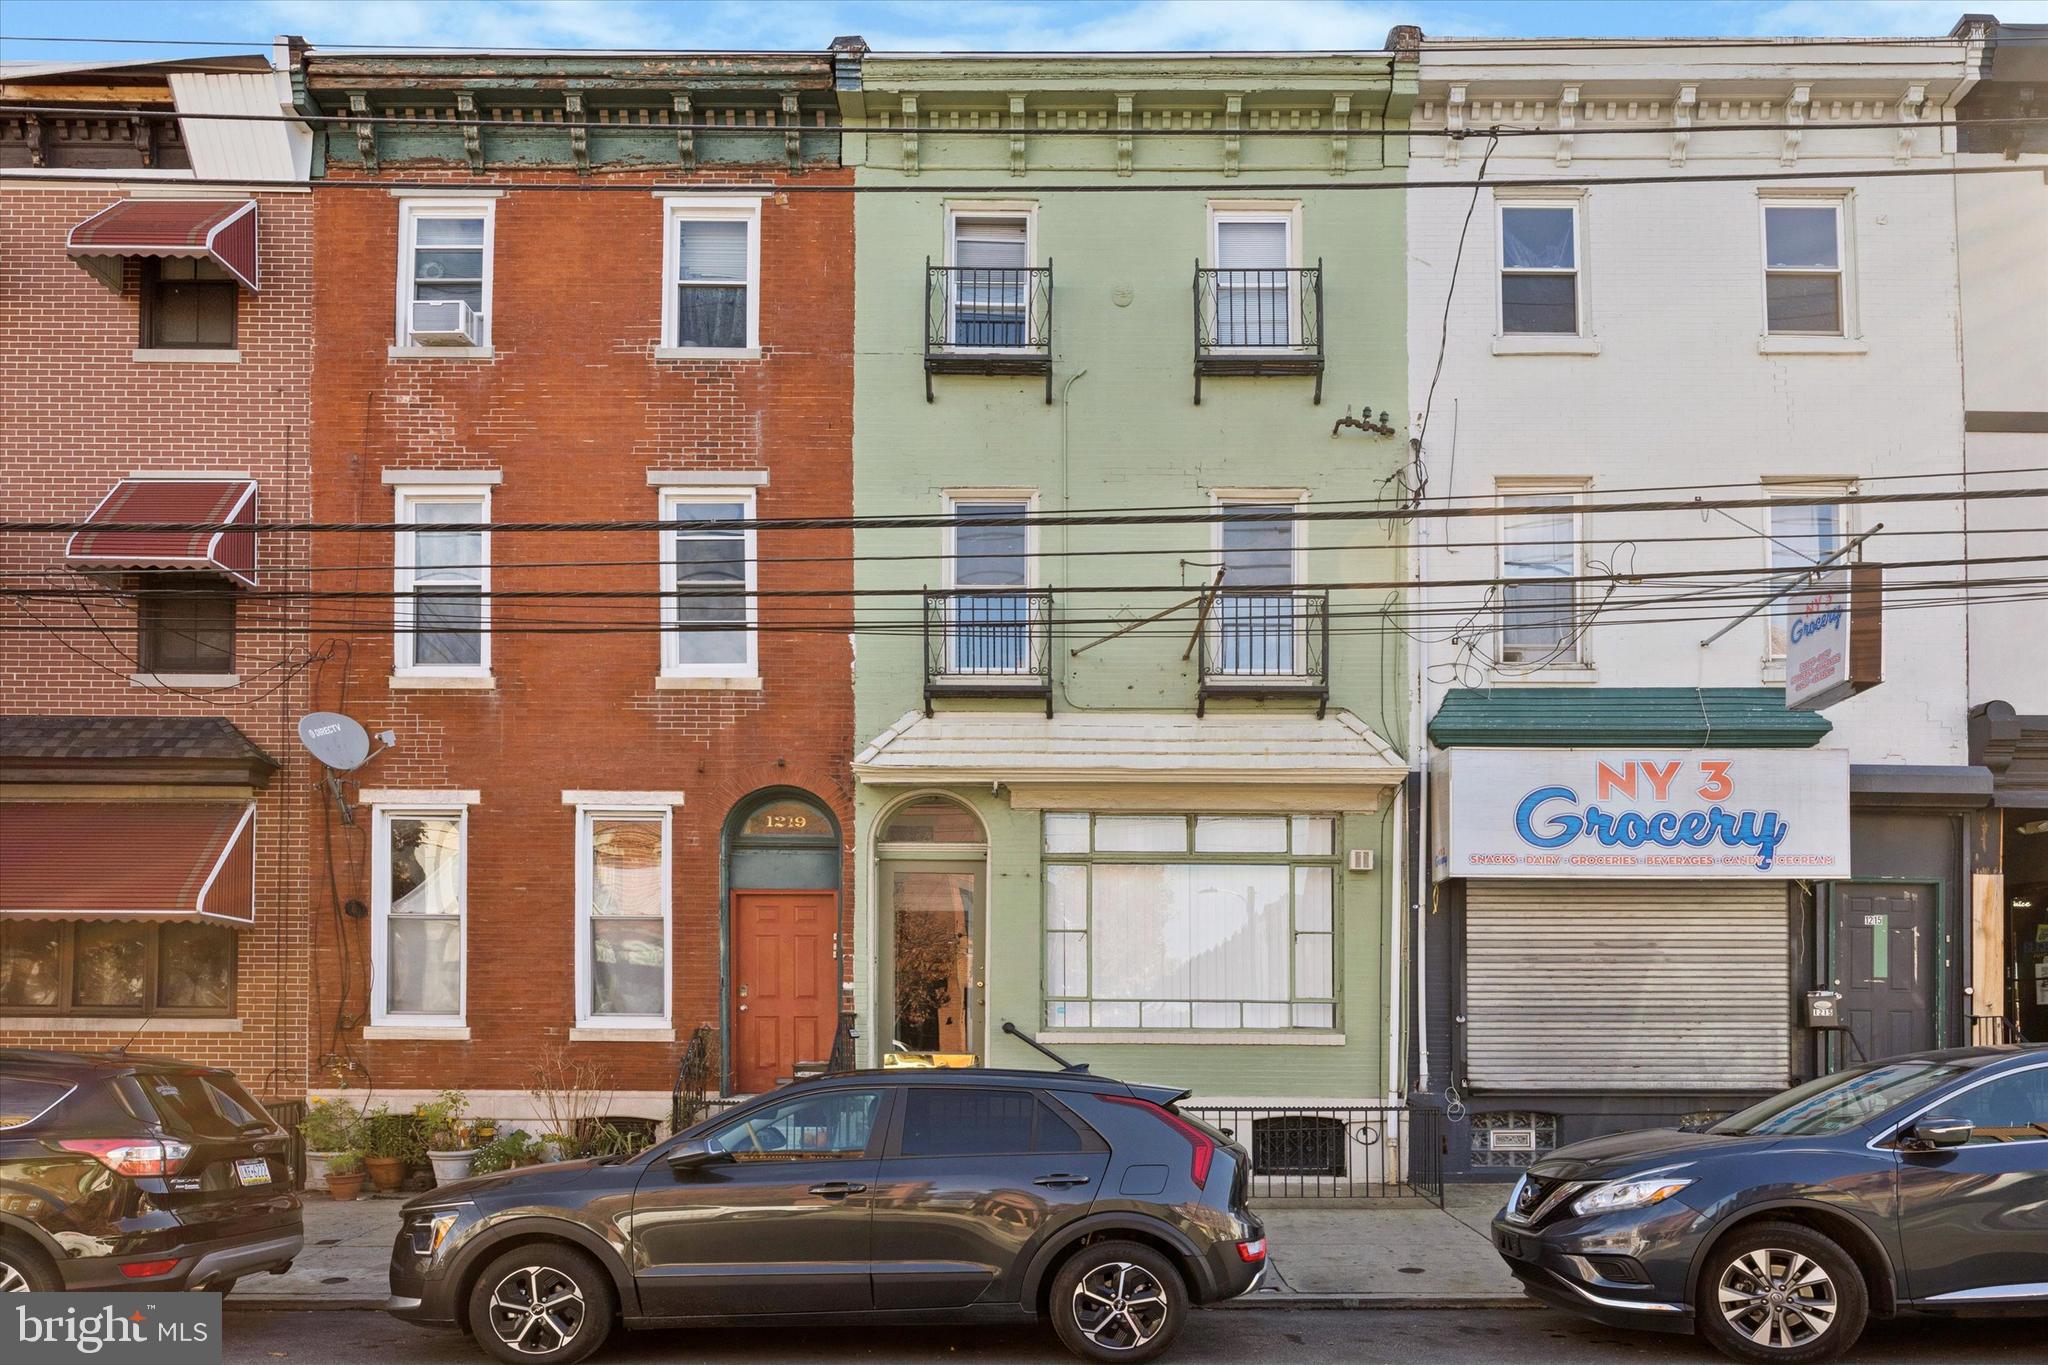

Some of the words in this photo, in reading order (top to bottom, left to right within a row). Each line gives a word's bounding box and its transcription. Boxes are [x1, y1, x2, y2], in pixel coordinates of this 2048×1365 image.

[1791, 604, 1842, 644] Grocery
[315, 724, 341, 737] DIRECTV
[1597, 760, 1681, 800] NY
[1697, 760, 1733, 800] 3
[1514, 786, 1789, 871] Grocery
[1469, 855, 1517, 865] SNACKS
[1525, 855, 1561, 865] DAIRY
[1570, 855, 1637, 865] GROCERIES
[1646, 855, 1713, 865] BEVERAGES
[1722, 855, 1765, 866] CANDY
[1865, 915, 1883, 925] 1215
